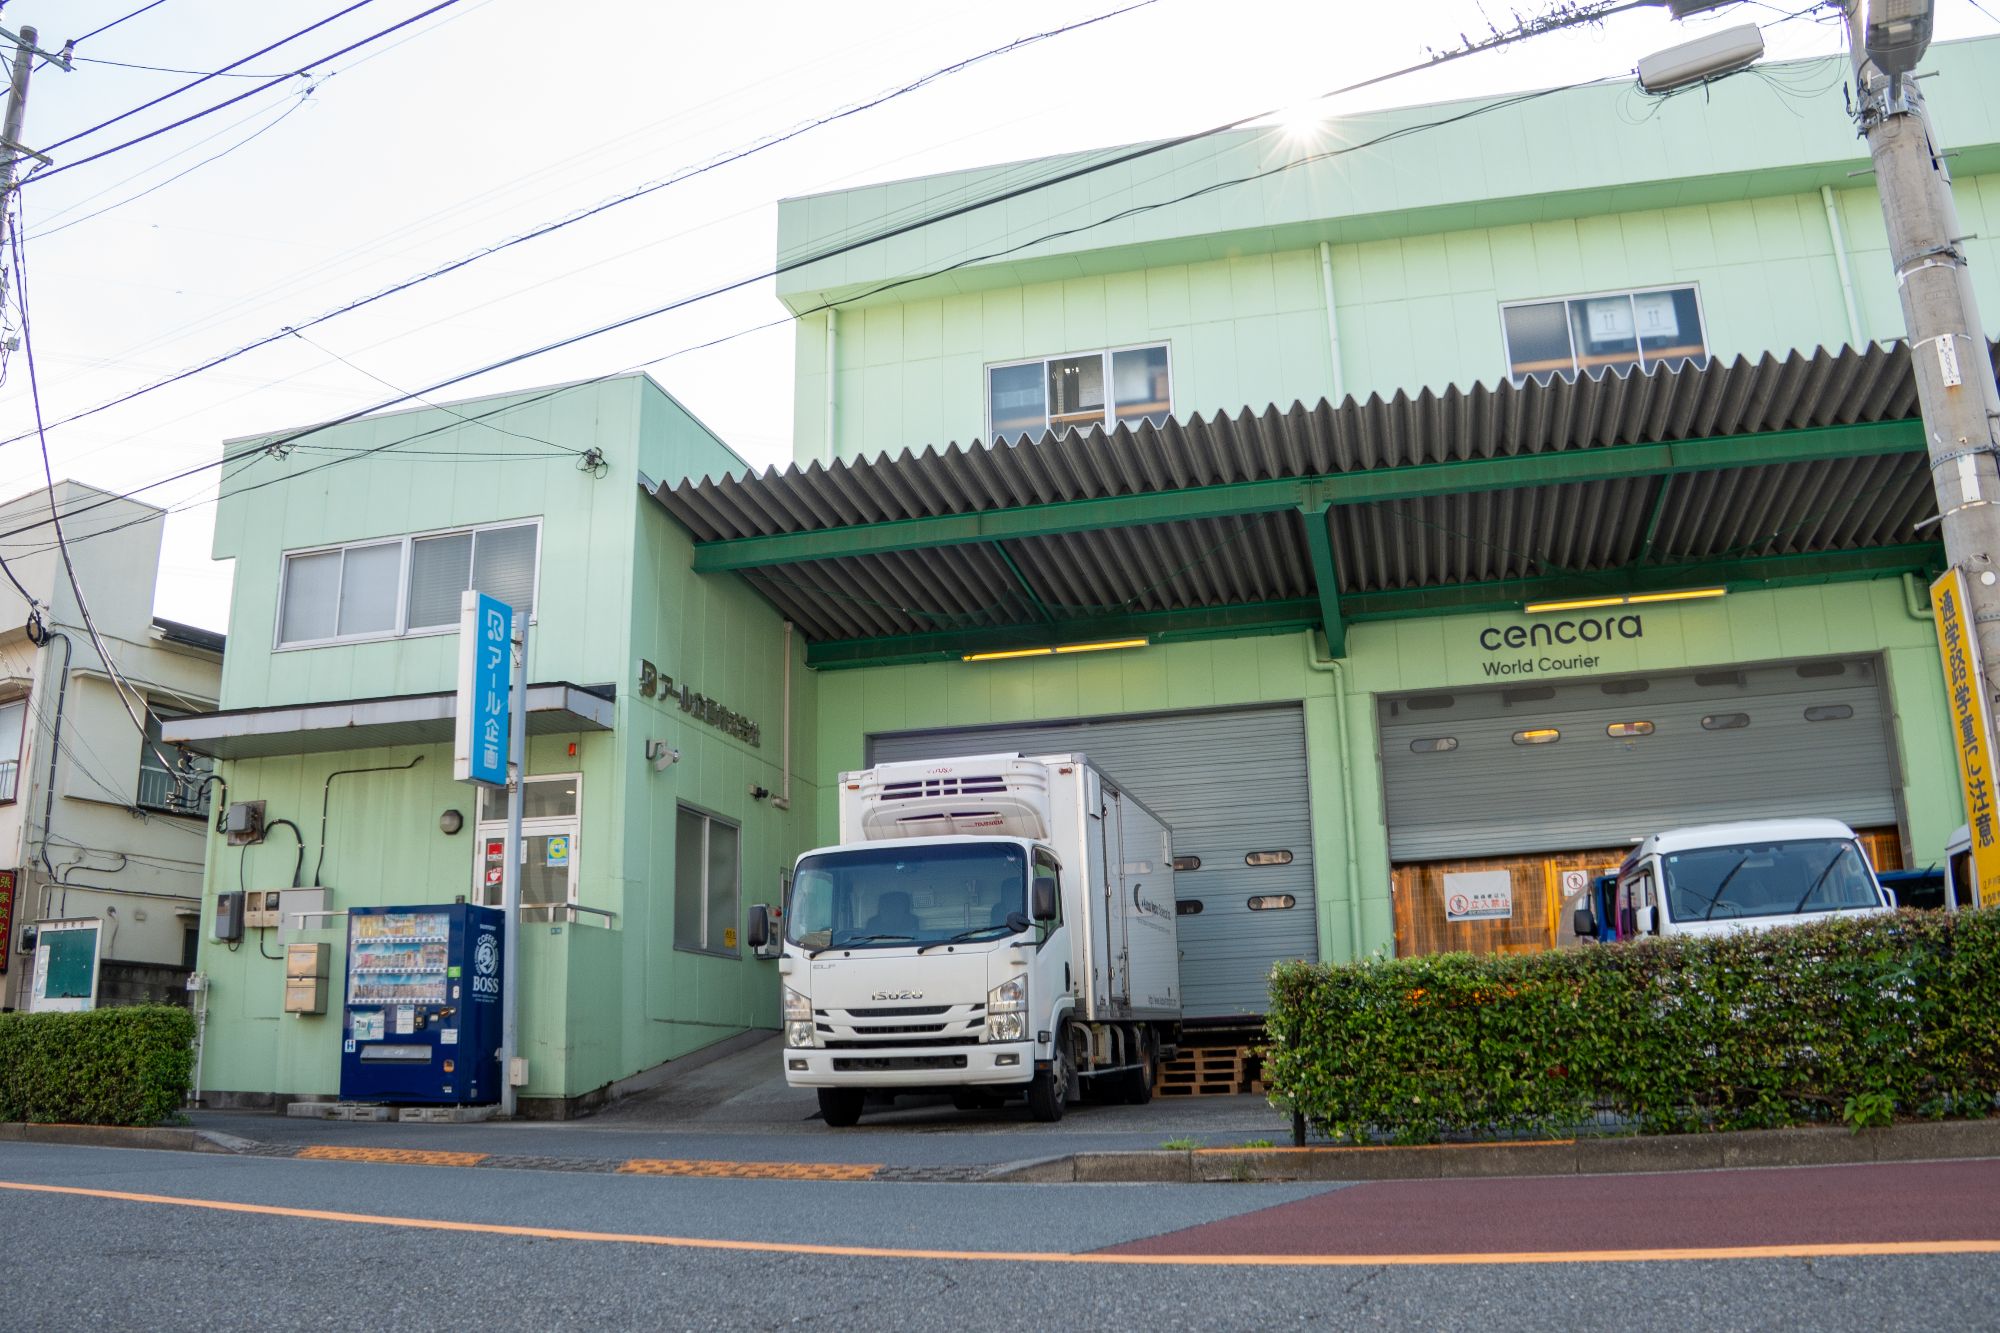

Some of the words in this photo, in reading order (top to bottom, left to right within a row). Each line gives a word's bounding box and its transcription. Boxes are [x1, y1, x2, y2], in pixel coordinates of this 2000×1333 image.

[1479, 614, 1643, 651] cencora
[1482, 659, 1534, 677] World
[1538, 654, 1600, 672] Courier
[484, 646, 502, 770] アール企画
[1939, 588, 1995, 850] 通学路学童に注意
[1470, 898, 1511, 910] 立入禁止
[477, 933, 498, 946] COFFEE
[472, 975, 499, 993] BOSS
[871, 988, 924, 1002] ISUZU
